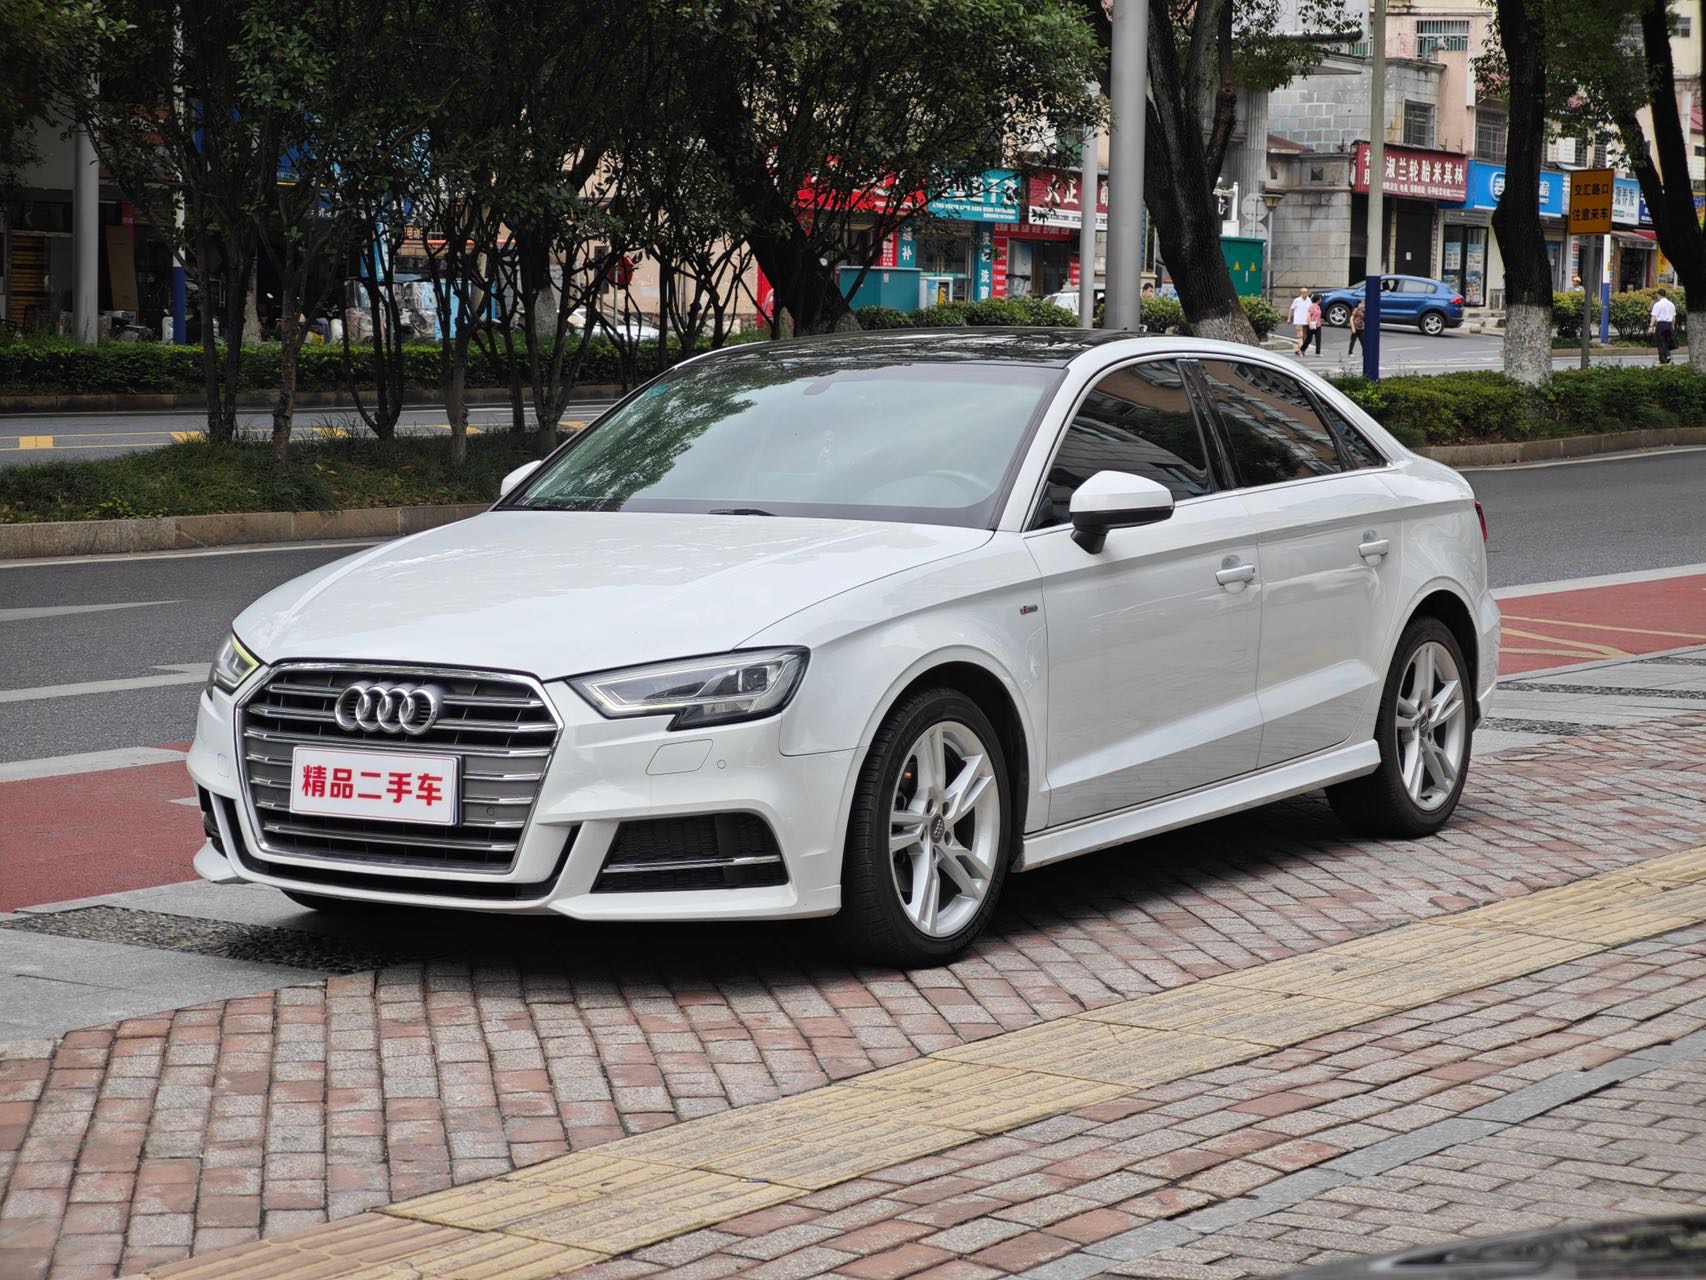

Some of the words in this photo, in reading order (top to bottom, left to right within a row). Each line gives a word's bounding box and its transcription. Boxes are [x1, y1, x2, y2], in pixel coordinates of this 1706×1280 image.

[1574, 184, 1609, 196] 交汇路口
[1572, 208, 1609, 221] 注意来车
[302, 764, 443, 806] 精品二手车
